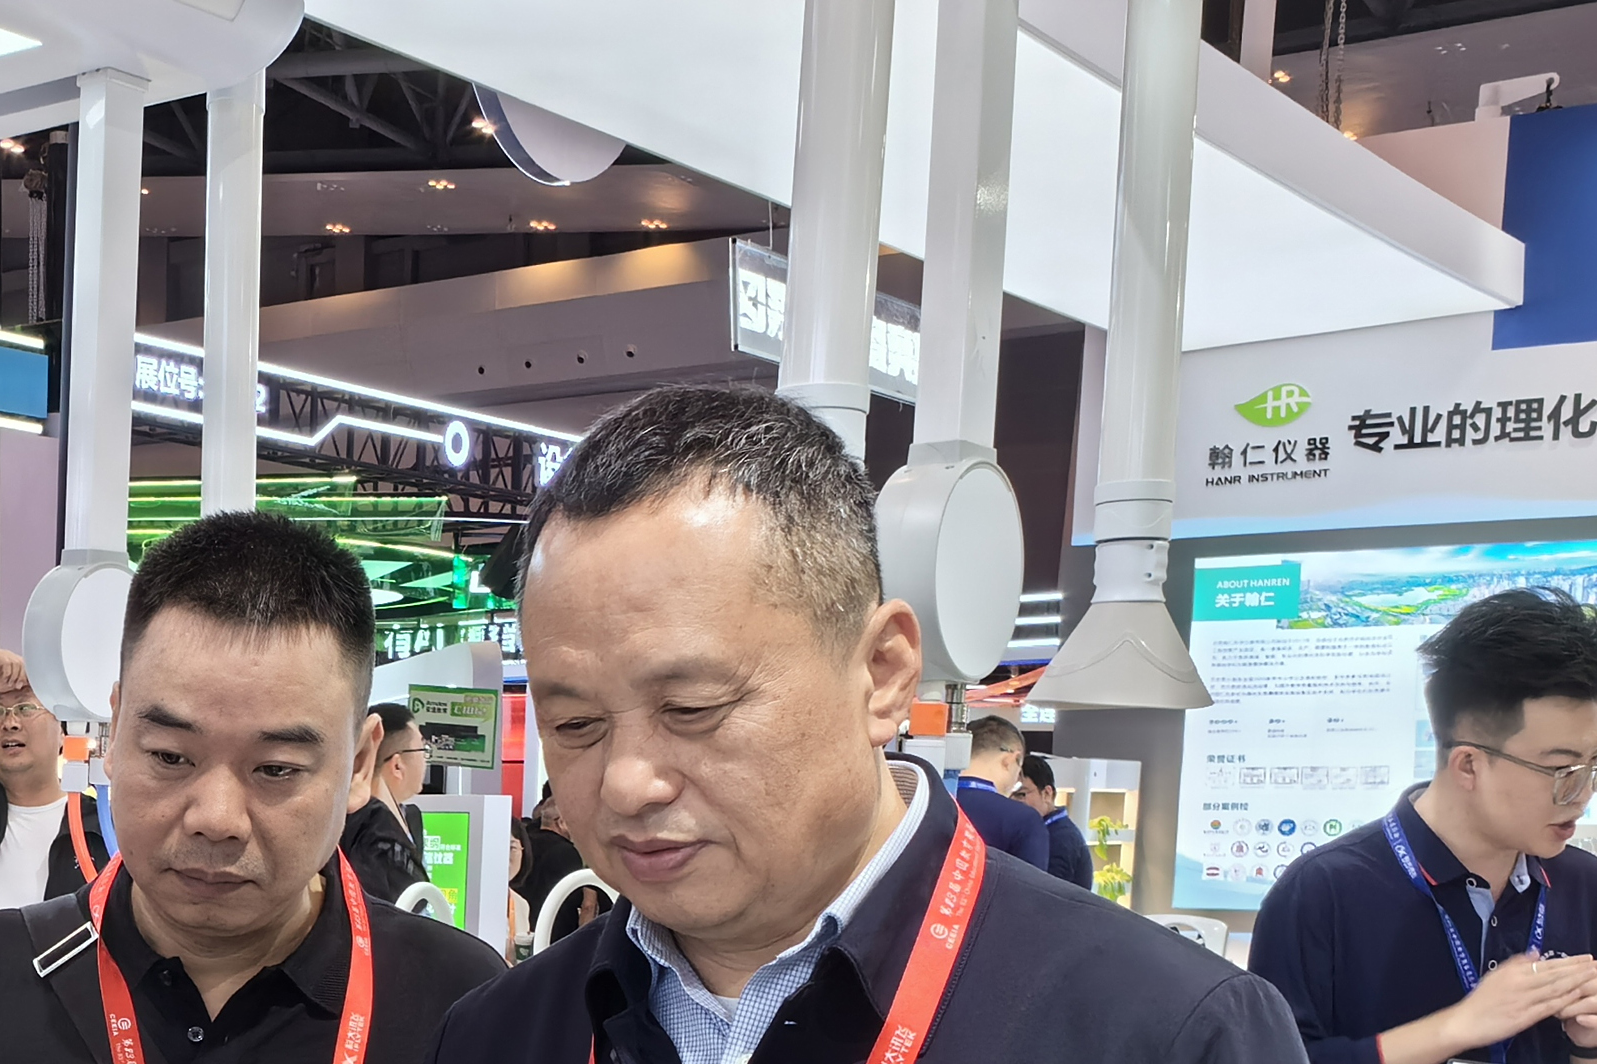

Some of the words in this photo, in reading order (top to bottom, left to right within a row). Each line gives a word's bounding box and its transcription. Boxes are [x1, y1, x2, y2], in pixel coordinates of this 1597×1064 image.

[1347, 392, 1597, 454] 专业的理化
[1208, 436, 1330, 471] 翰仁仪器
[1205, 475, 1242, 487] HANR
[1247, 467, 1330, 484] INSTRUMENT
[1216, 580, 1248, 589] ABOUT
[1252, 577, 1290, 587] HANREN
[945, 924, 960, 950] CEEIA
